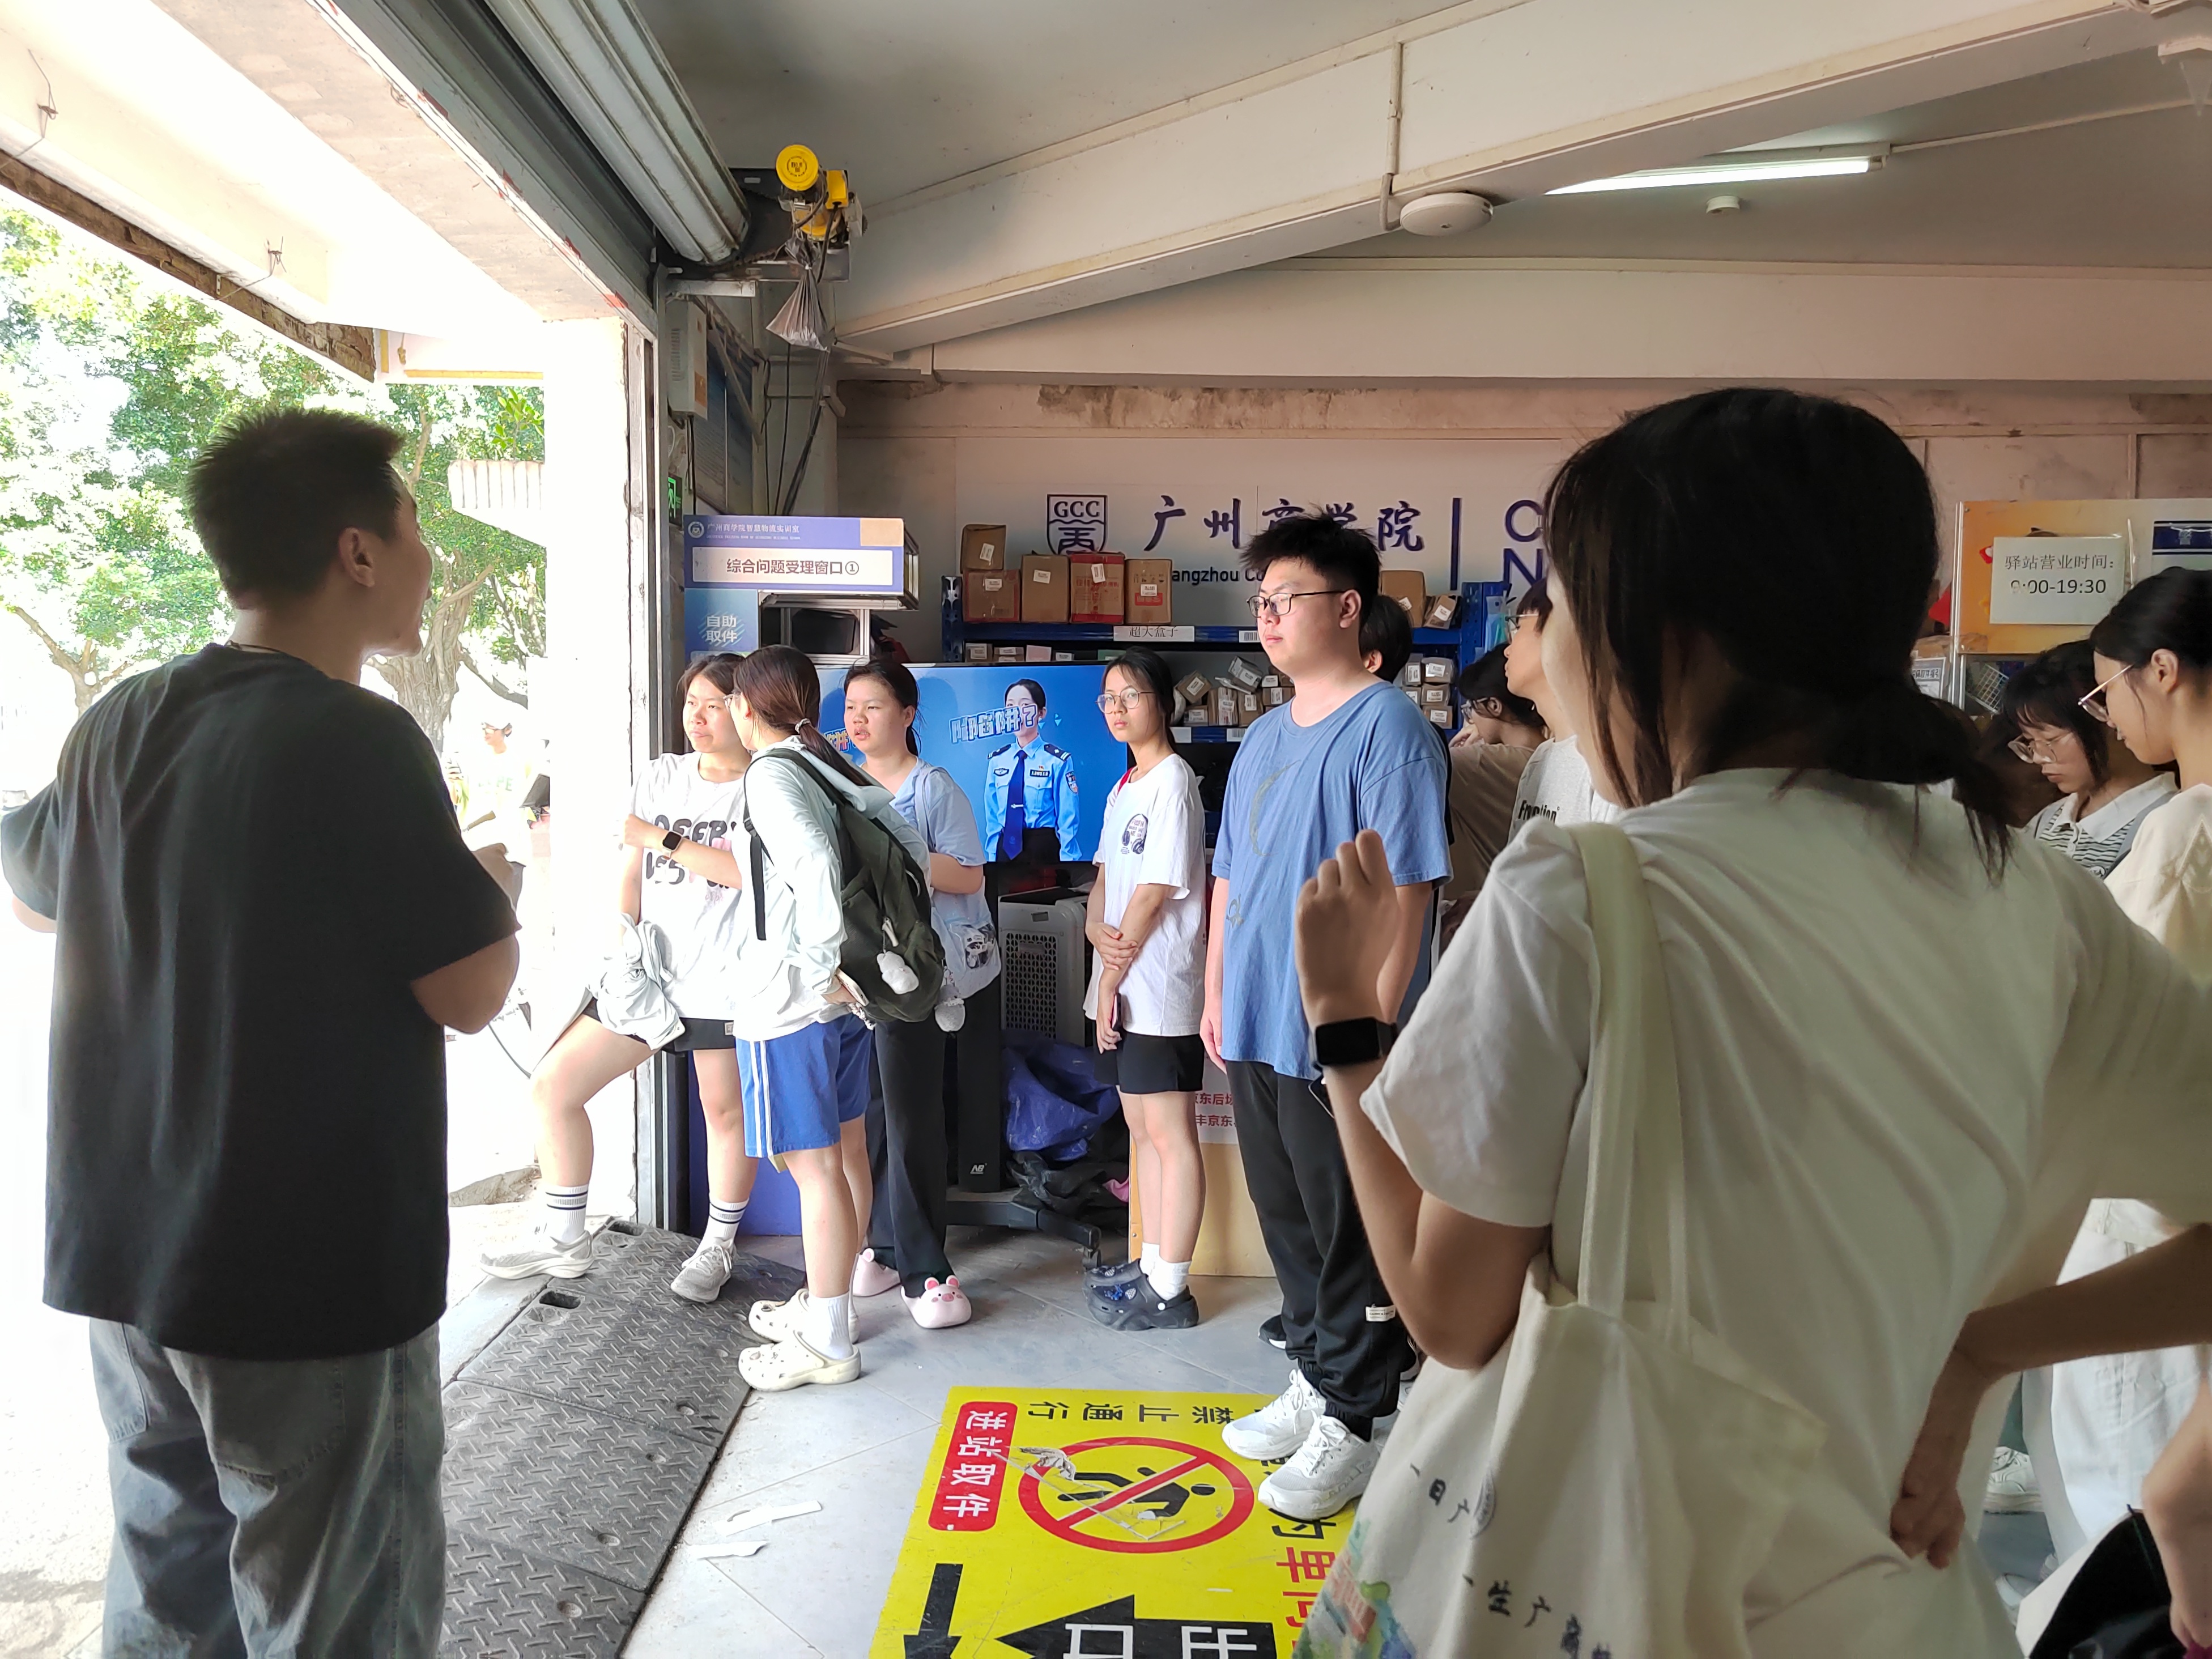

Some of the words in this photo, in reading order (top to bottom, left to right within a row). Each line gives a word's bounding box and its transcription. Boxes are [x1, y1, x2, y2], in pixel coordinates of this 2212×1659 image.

[1054, 500, 1100, 518] GCC
[726, 558, 860, 575] 综合问题受理窗口①
[2005, 554, 2114, 571] 驿站营业时间:
[1172, 567, 1239, 586] angzhou
[707, 615, 737, 628] 自助
[706, 630, 738, 644] 取件
[1129, 626, 1179, 637] 超大盒子
[1196, 1114, 1236, 1127] 丰京东
[1028, 1402, 1261, 1424] 禁止通行
[942, 1410, 1007, 1518] 进站取件
